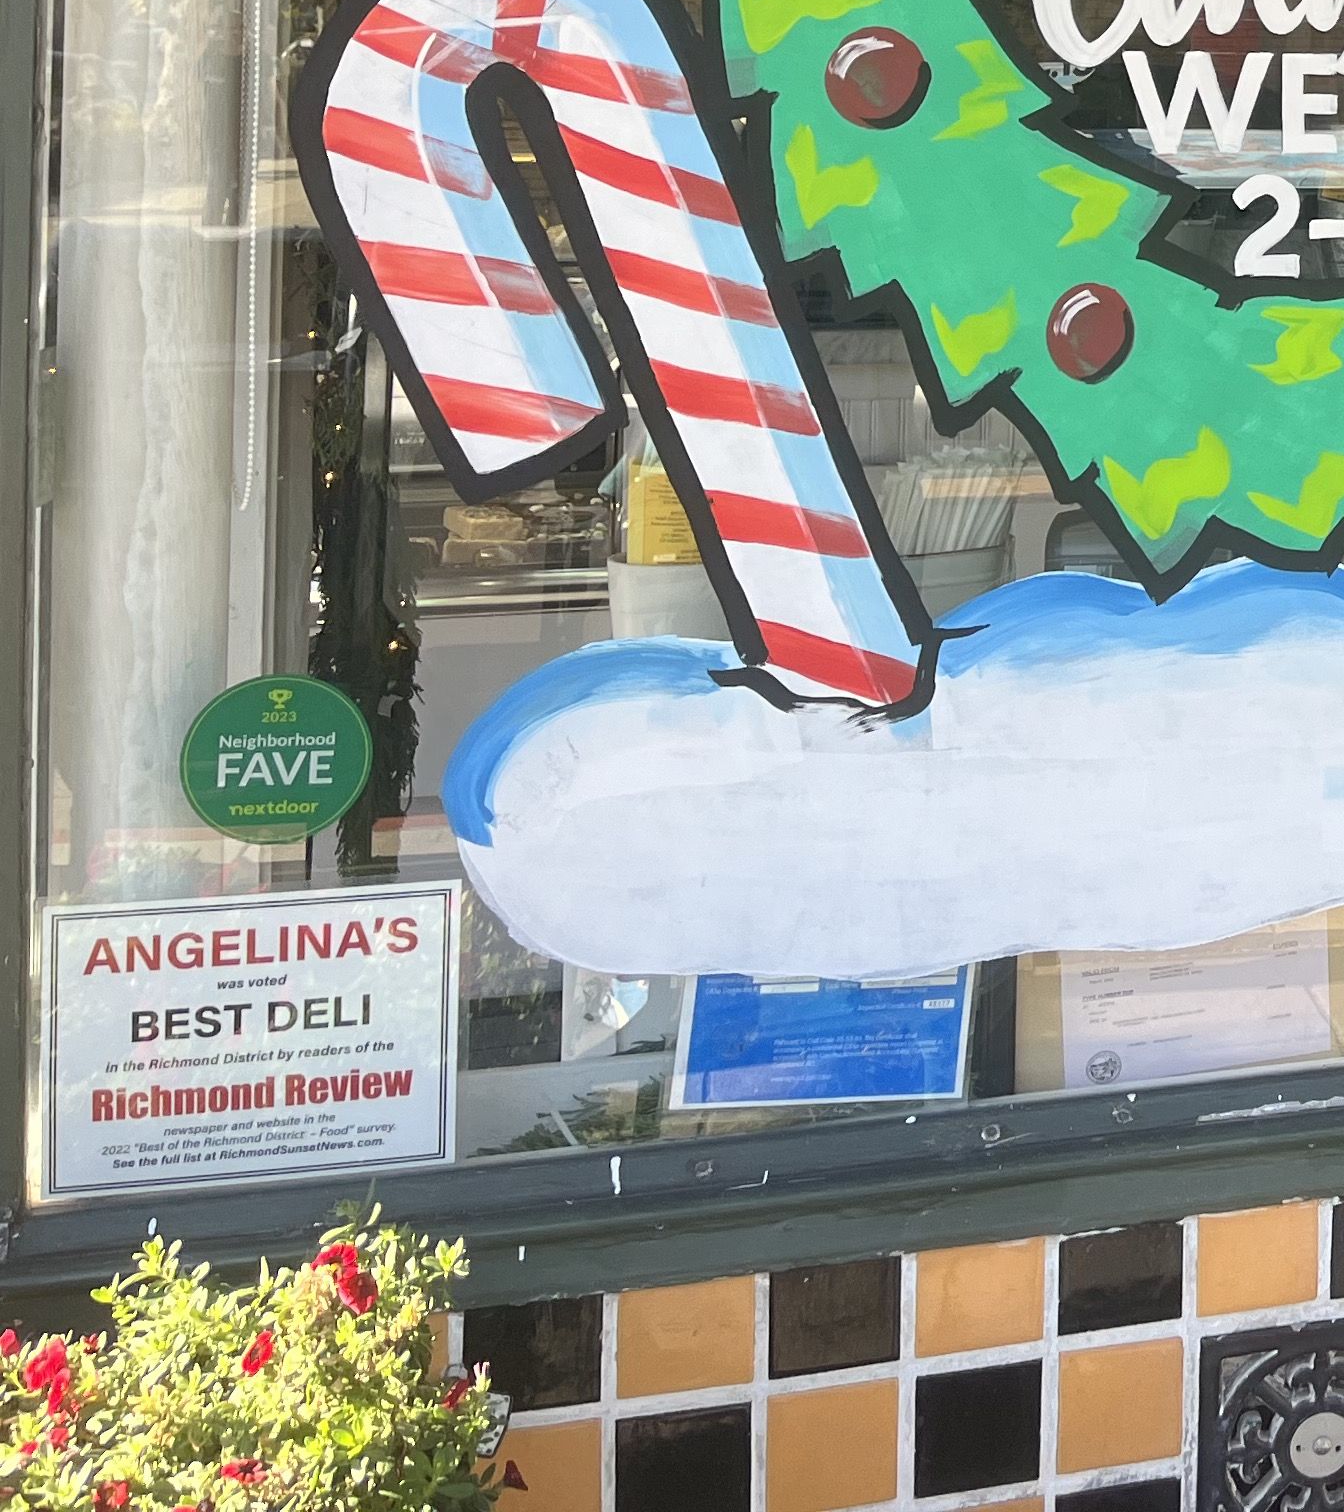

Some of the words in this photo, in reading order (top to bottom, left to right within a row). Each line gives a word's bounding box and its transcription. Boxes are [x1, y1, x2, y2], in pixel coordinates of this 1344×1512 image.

[261, 711, 297, 723] 2023
[218, 731, 336, 750] Neighborhood
[216, 750, 335, 788] FAVE
[228, 799, 319, 816] nextdoor
[83, 917, 419, 976] ANGELINA'S
[216, 978, 245, 990] was
[248, 974, 288, 988] voted
[131, 1003, 253, 1043] BEST
[267, 994, 371, 1033] DELI
[105, 1061, 119, 1074] in
[122, 1059, 145, 1072] the
[149, 1053, 219, 1071] Richmond
[223, 1050, 274, 1065] District
[277, 1048, 294, 1063] by
[298, 1044, 351, 1059] readers
[355, 1040, 370, 1054] of
[372, 1040, 395, 1053] the
[91, 1076, 275, 1122] Richmond
[284, 1068, 414, 1106] Review
[163, 1123, 228, 1138] newspaper
[231, 1120, 253, 1132] and
[256, 1116, 301, 1128] website
[303, 1115, 315, 1125] in
[318, 1113, 336, 1124] the
[101, 1145, 131, 1156] 2022
[168, 1140, 179, 1151] of
[182, 1139, 201, 1150] the
[203, 1133, 262, 1148] Richmond
[265, 1131, 306, 1142] District
[113, 1158, 135, 1169] See
[138, 1157, 158, 1167] the
[161, 1155, 180, 1166] full
[183, 1153, 201, 1163] list
[204, 1152, 217, 1161] at
